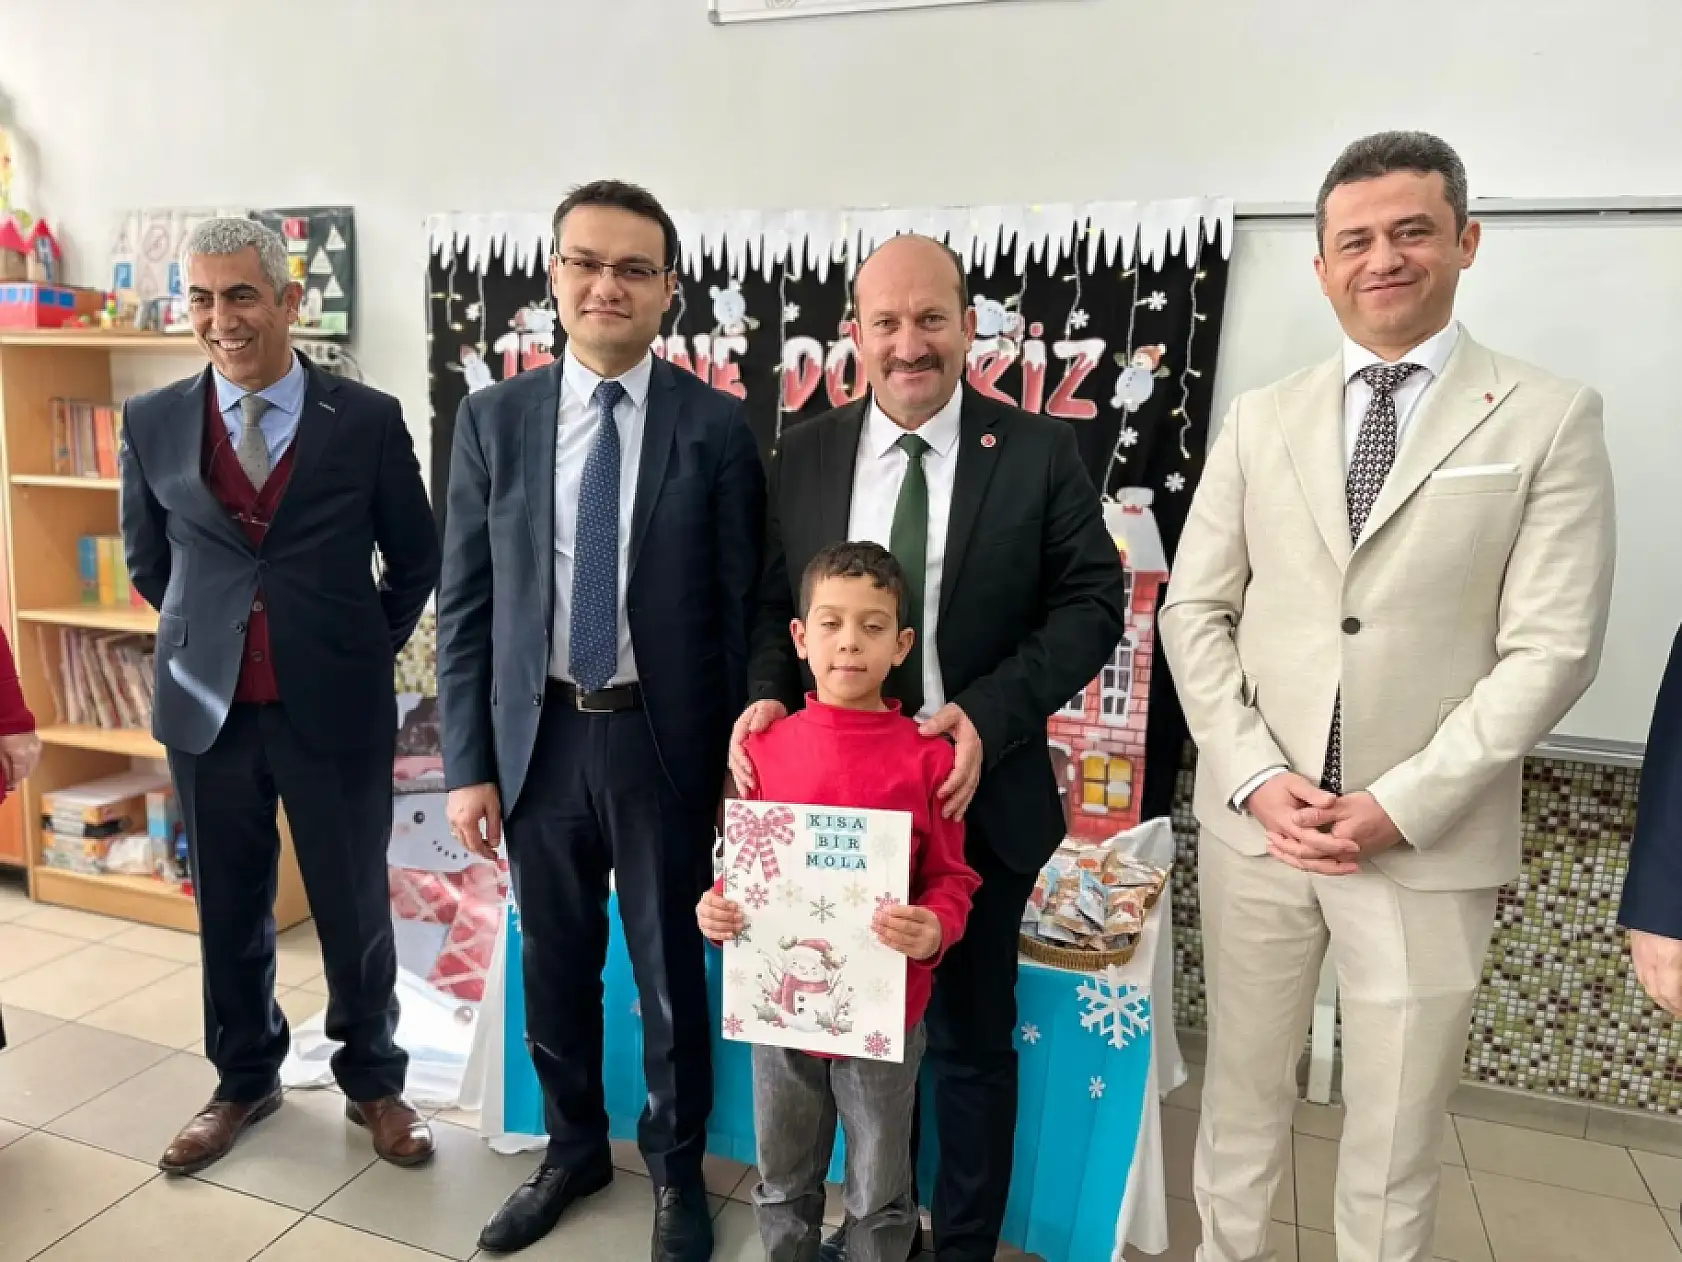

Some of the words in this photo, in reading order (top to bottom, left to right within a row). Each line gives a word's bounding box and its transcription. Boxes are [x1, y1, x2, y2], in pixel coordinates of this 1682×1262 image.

[779, 320, 1107, 420] DÖRİZ
[809, 814, 864, 829] KISA
[818, 834, 860, 849] BİR
[806, 854, 866, 869] MOLA
